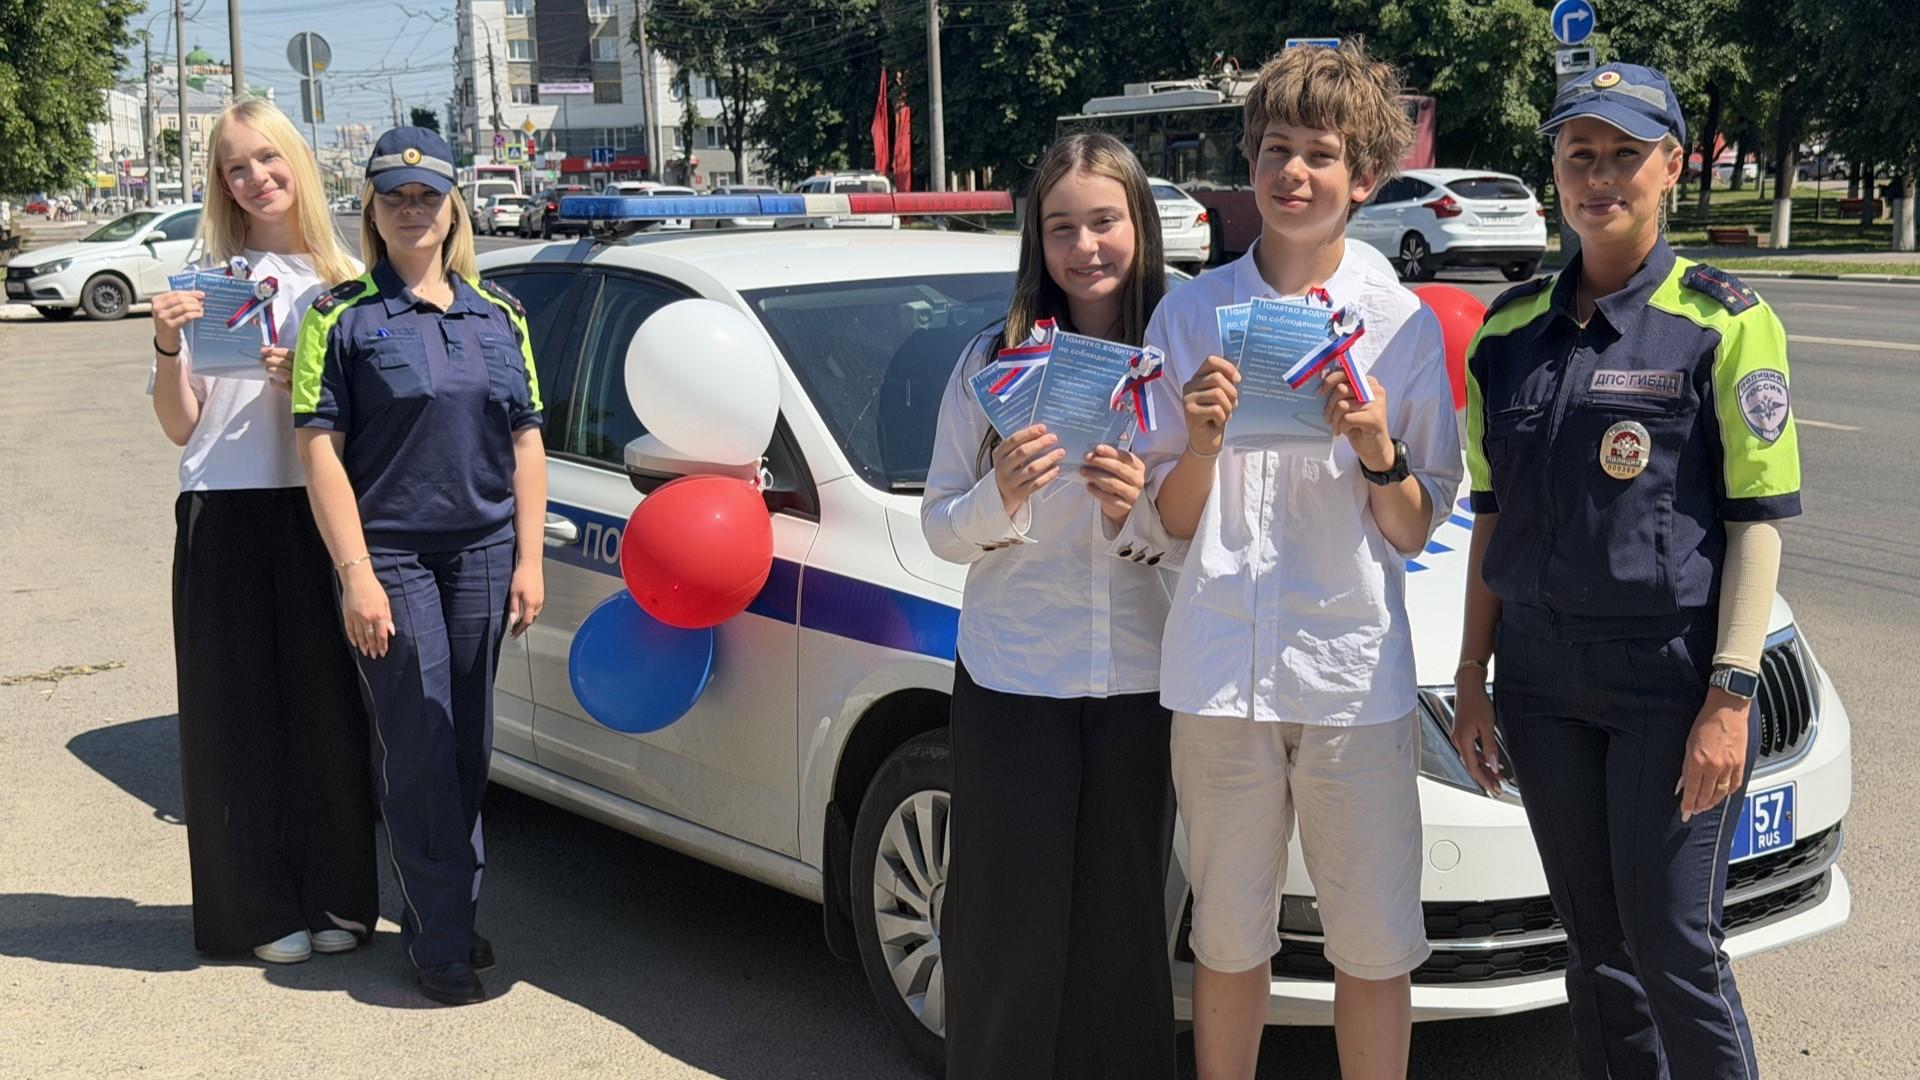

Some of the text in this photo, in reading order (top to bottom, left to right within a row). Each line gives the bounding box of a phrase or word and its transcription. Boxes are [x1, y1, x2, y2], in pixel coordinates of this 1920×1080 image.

[1258, 299, 1331, 319] Памятка водит
[1256, 313, 1325, 330] по соблюдению
[1061, 334, 1101, 349] Памятка
[1058, 346, 1069, 354] по
[1070, 347, 1124, 367] соблюдению
[1595, 374, 1678, 393] ДПС ГИБДД
[1740, 372, 1783, 391] ПОЛИЦИЯ
[1745, 383, 1783, 403] РОССИЯ
[1754, 791, 1784, 833] 57
[1758, 830, 1781, 849] RUS
